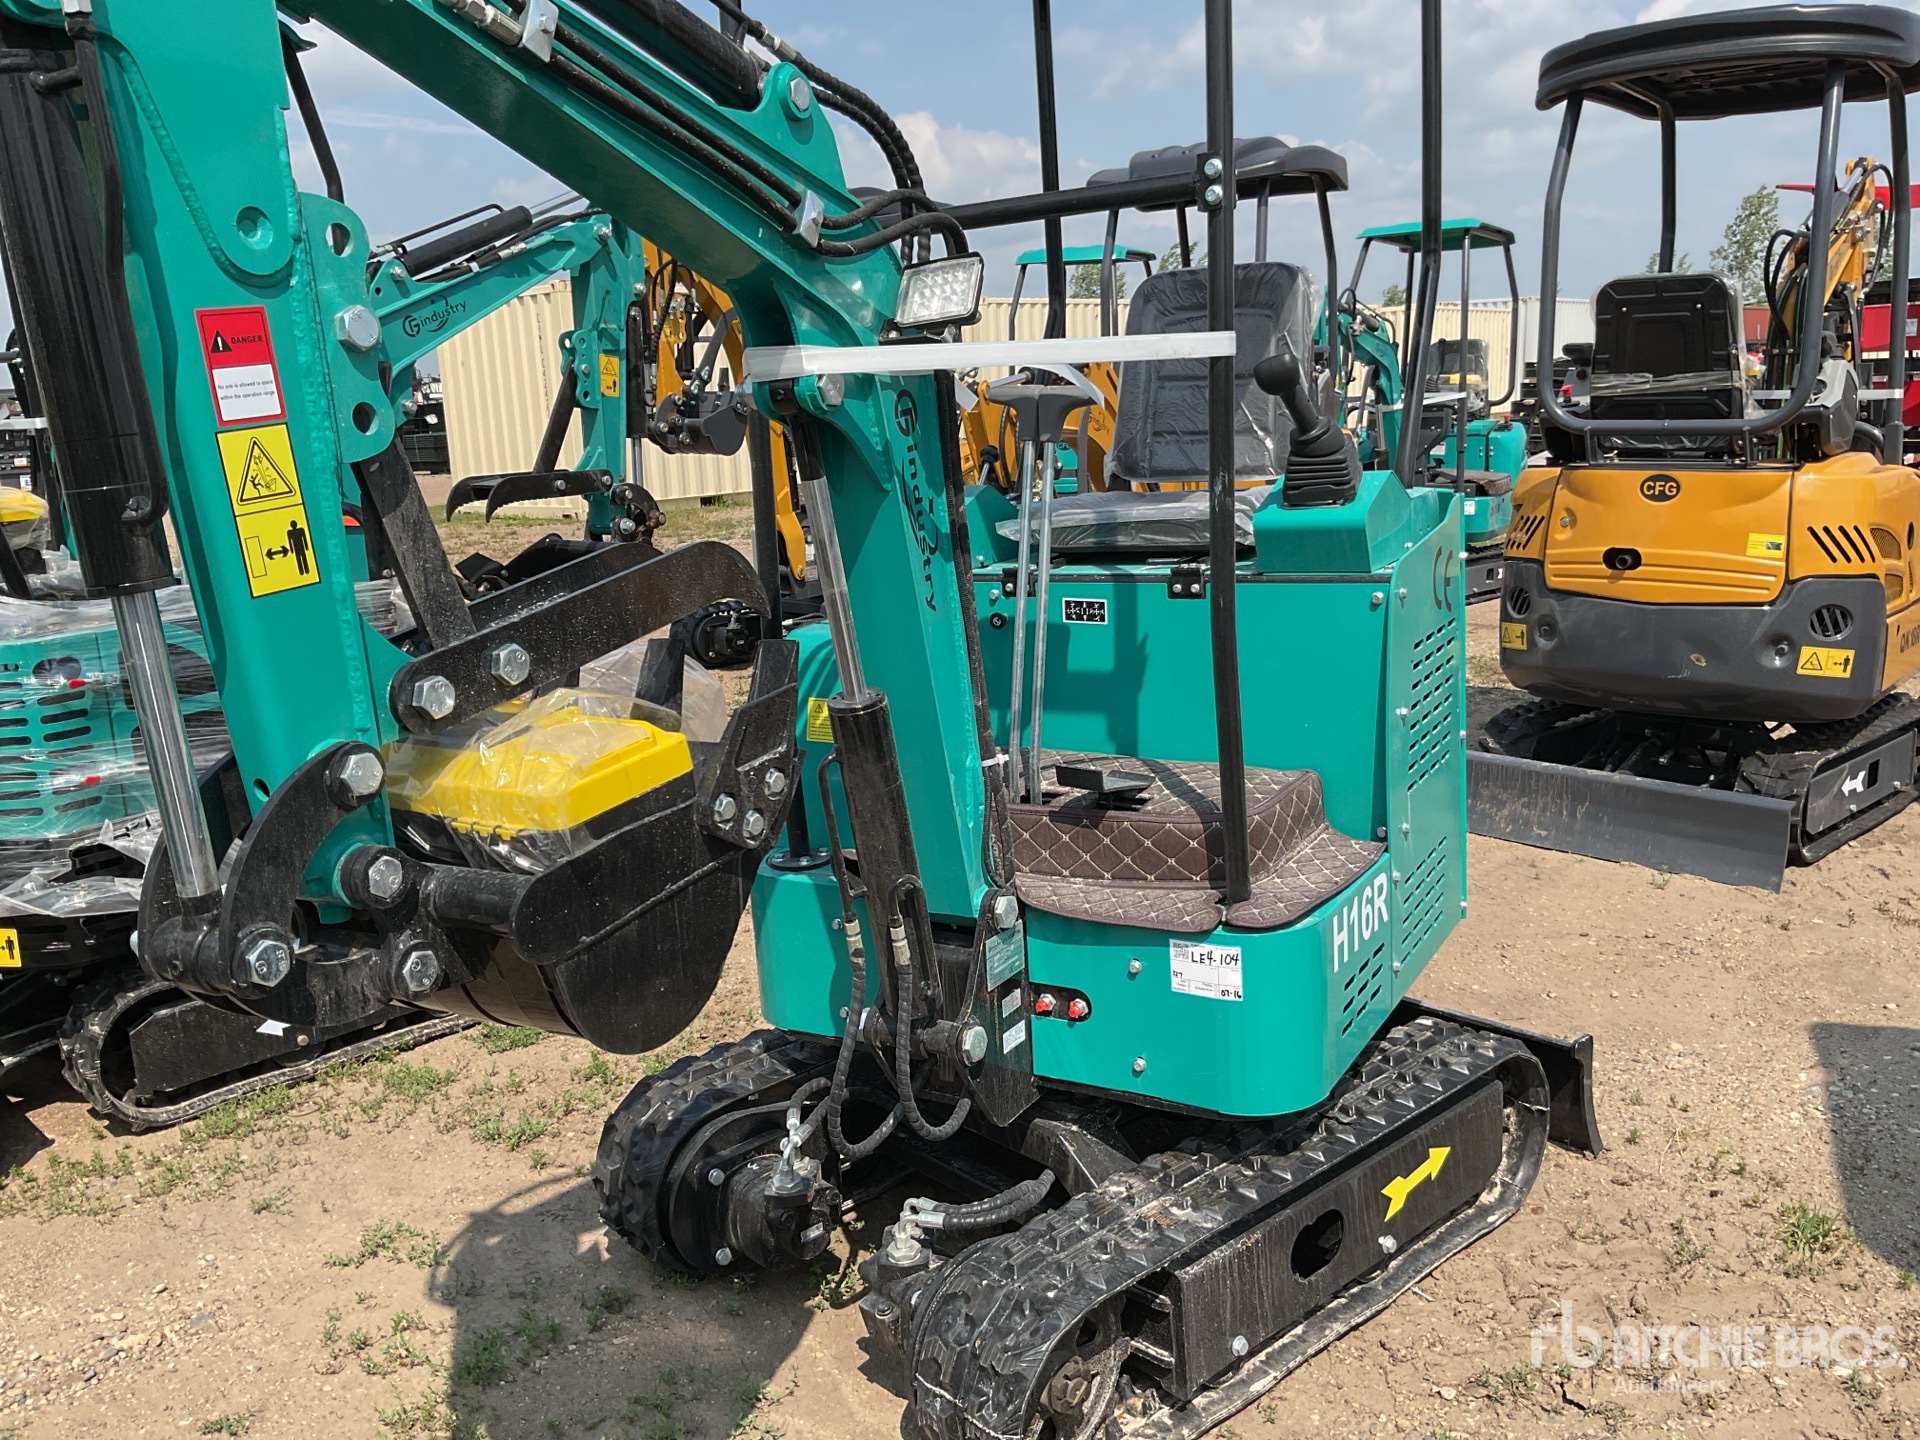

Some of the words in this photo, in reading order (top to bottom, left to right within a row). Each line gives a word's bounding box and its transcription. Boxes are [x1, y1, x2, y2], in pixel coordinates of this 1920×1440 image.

[230, 335, 263, 345] DANGER
[242, 391, 262, 399] operation
[1643, 481, 1677, 496] CFG
[1333, 872, 1388, 973] H16R
